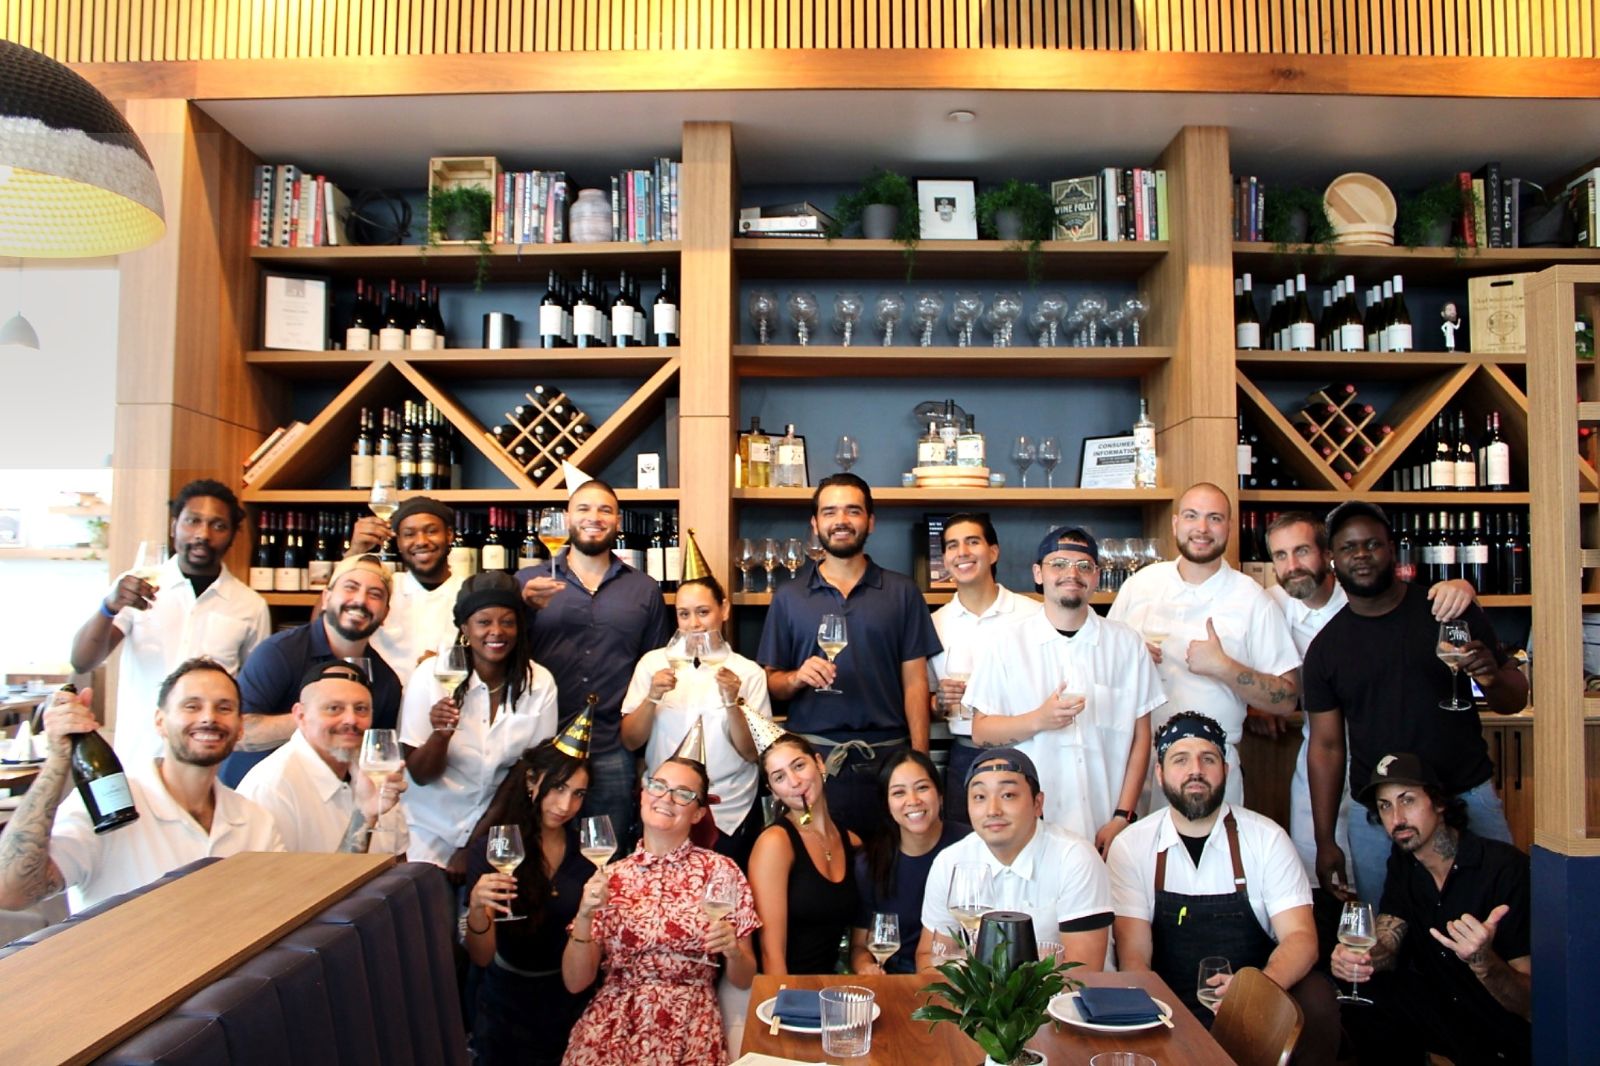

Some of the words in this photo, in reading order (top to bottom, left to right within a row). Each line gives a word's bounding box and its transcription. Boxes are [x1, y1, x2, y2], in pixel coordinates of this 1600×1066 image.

[1054, 204, 1073, 215] WINE
[1074, 201, 1095, 212] FOLLY
[1093, 448, 1136, 456] INFORMATIO
